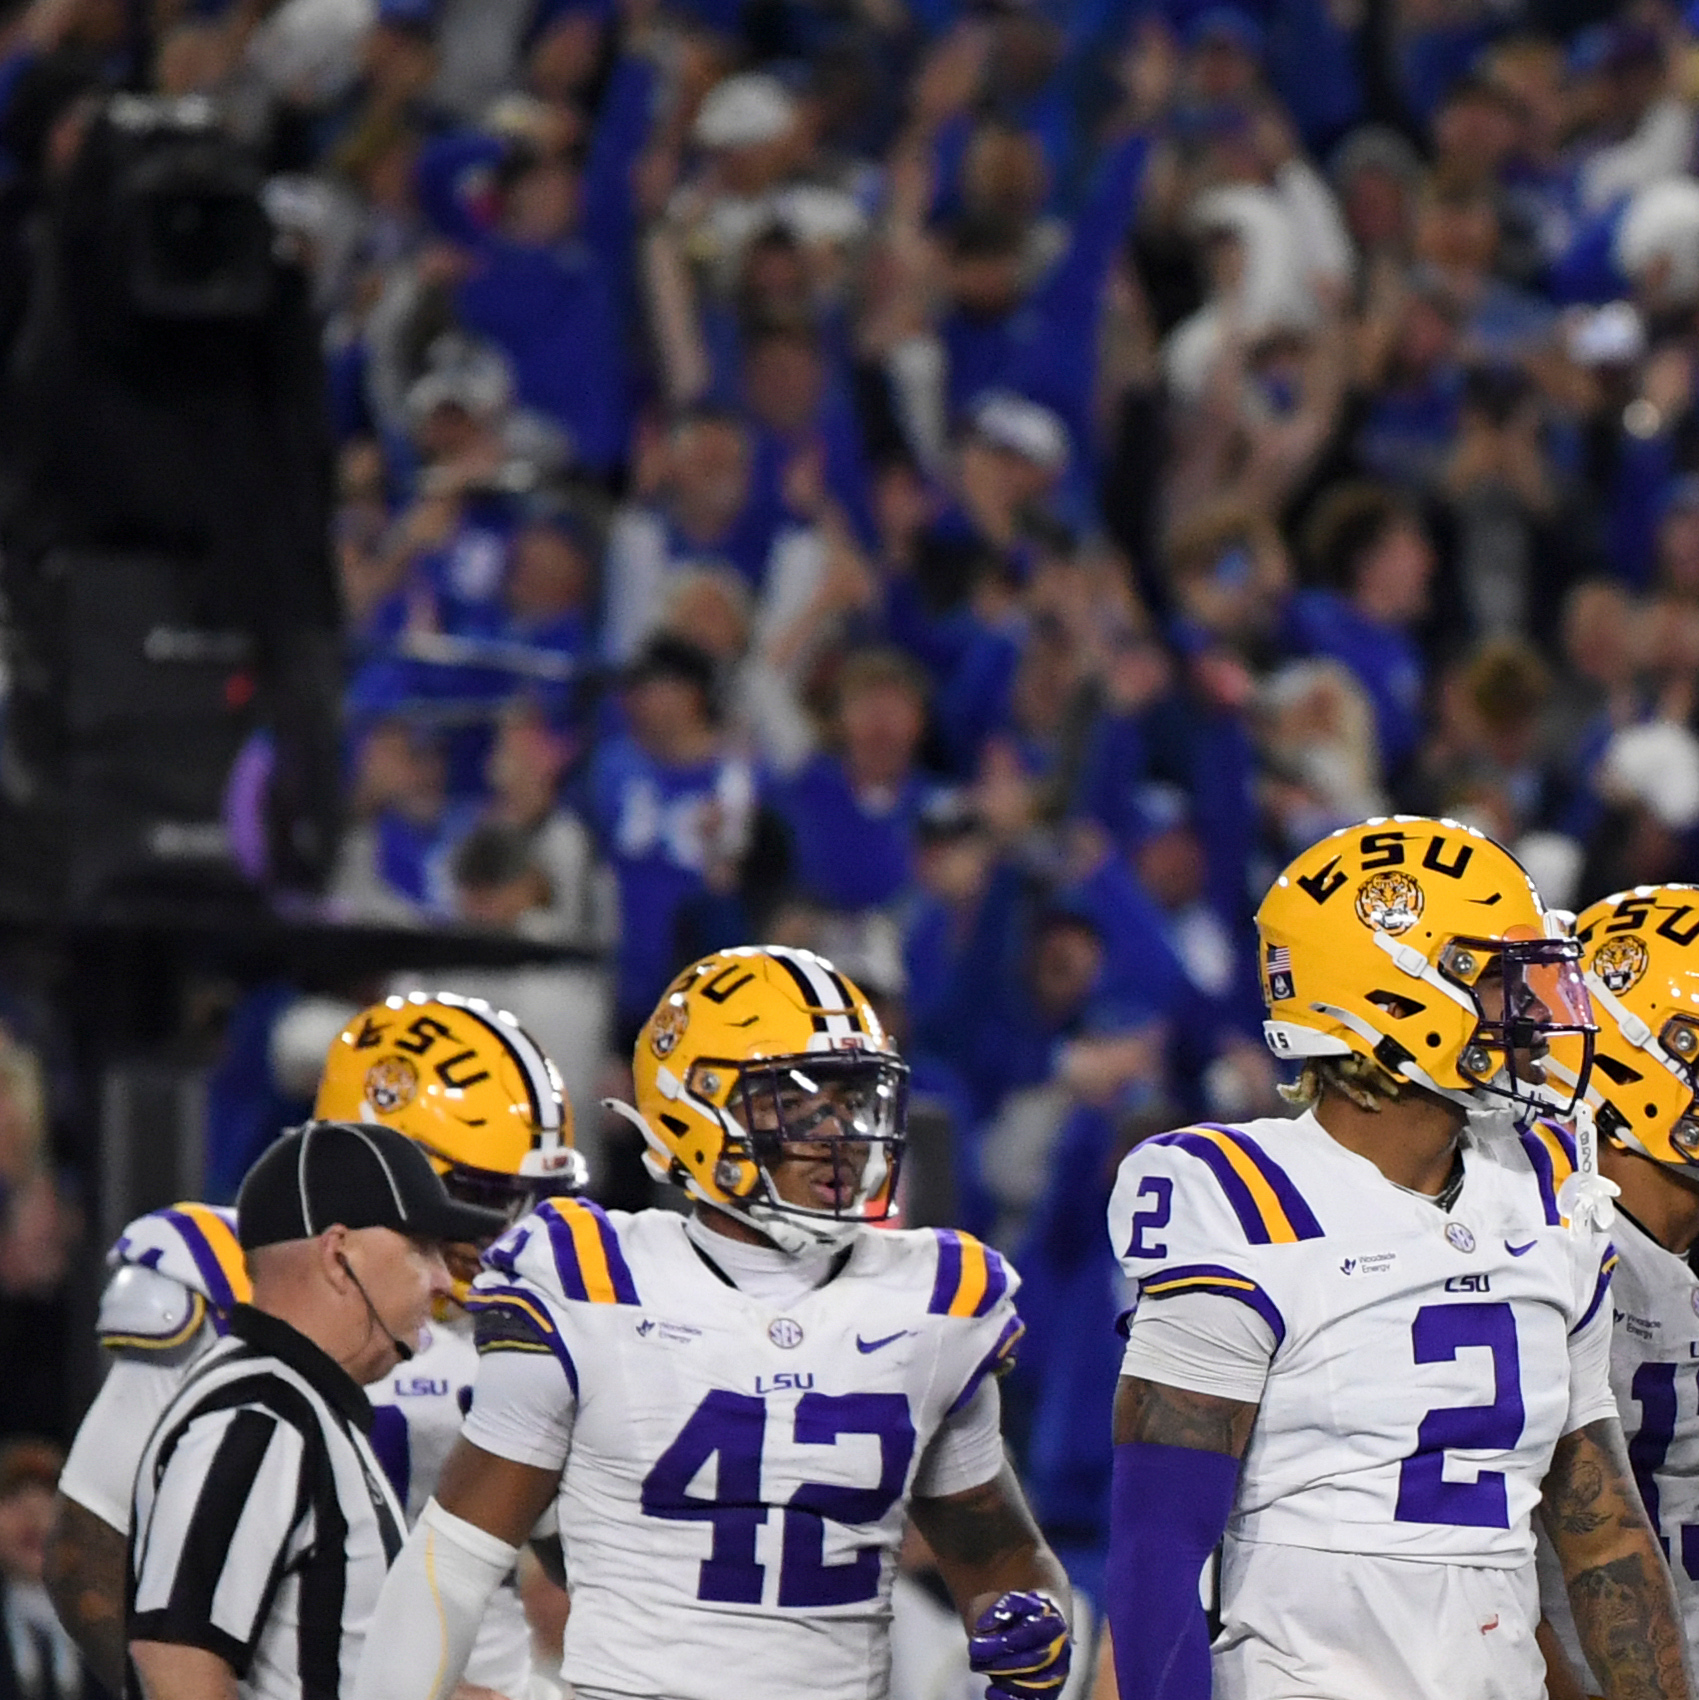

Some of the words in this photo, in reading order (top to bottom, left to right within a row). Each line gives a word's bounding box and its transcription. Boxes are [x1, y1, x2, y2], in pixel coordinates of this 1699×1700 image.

[1296, 831, 1474, 906] LSU
[354, 1016, 491, 1091] LSU
[1124, 1176, 1172, 1260] 2
[1359, 1252, 1396, 1264] Woodside
[1361, 1262, 1391, 1274] Energy
[1444, 1275, 1491, 1292] LSU
[394, 1379, 448, 1396] LSU
[755, 1373, 814, 1394] LSU
[1394, 1301, 1527, 1529] 2
[641, 1388, 917, 1608] 42
